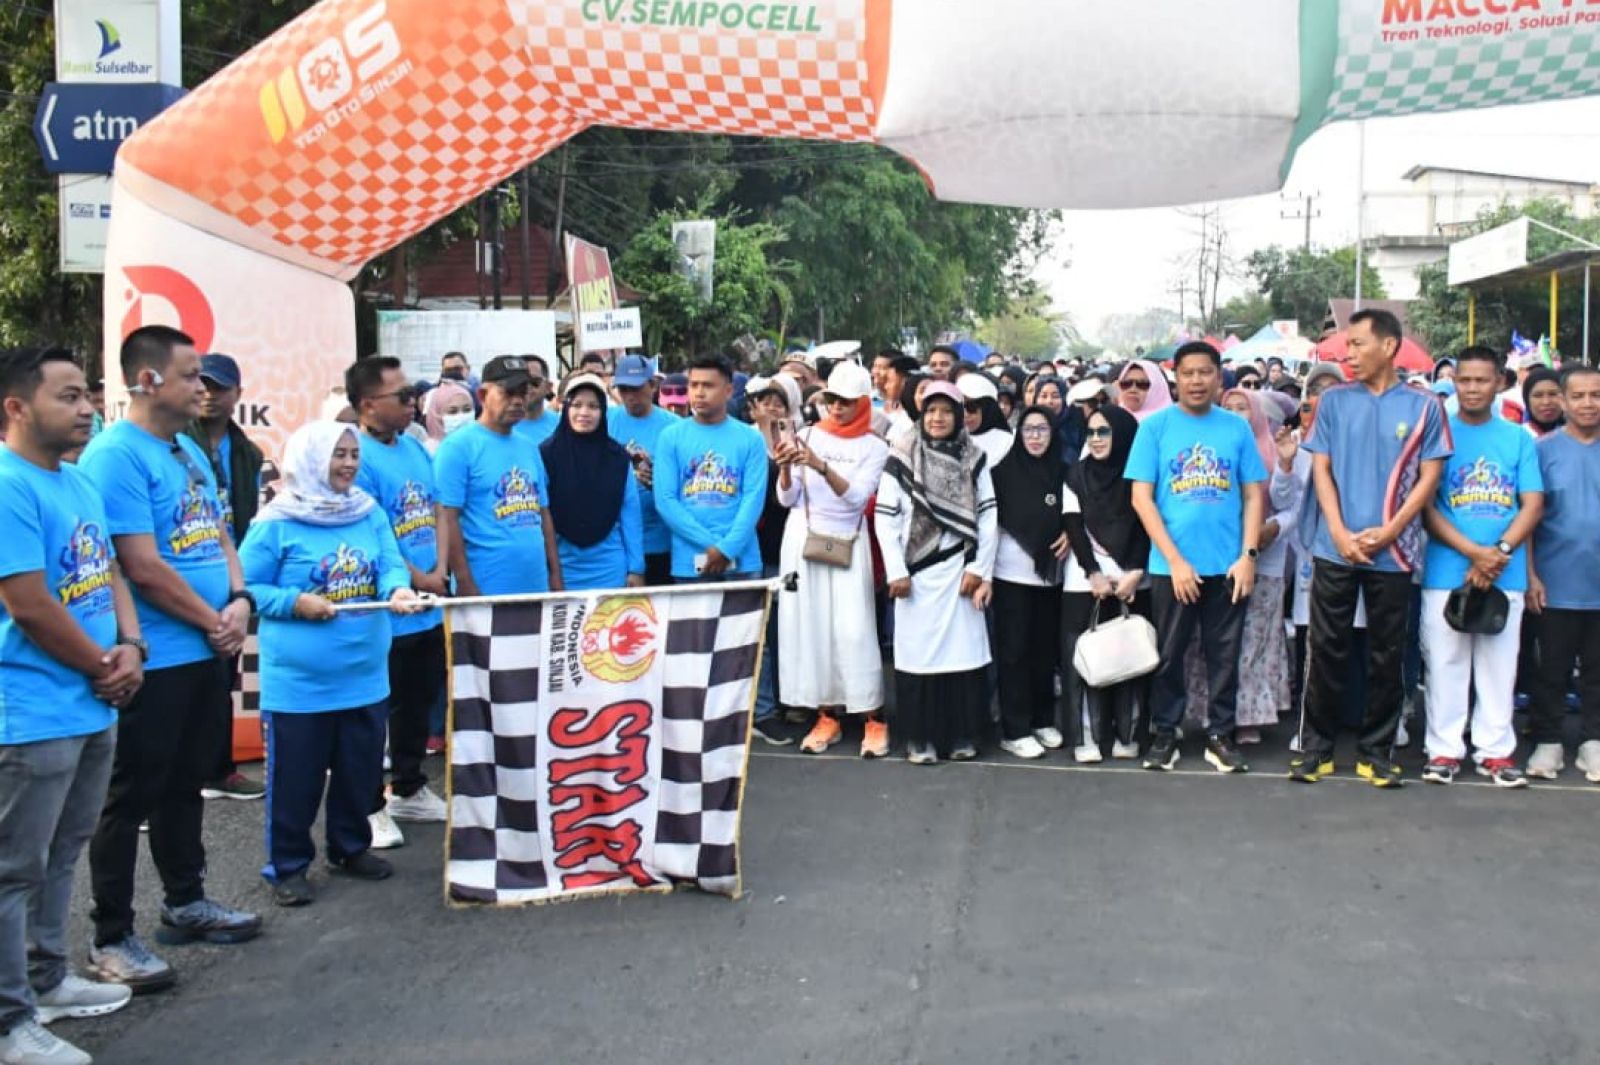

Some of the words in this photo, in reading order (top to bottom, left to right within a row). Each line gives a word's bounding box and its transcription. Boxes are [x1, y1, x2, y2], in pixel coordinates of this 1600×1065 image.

[581, 0, 821, 32] CV.SEMPOCELL
[1381, 30, 1418, 42] Tren
[1520, 12, 1570, 29] Solusi
[73, 109, 138, 140] atm
[567, 604, 586, 688] INDONESIA
[548, 657, 565, 693] SINJAI
[548, 699, 655, 891] START
